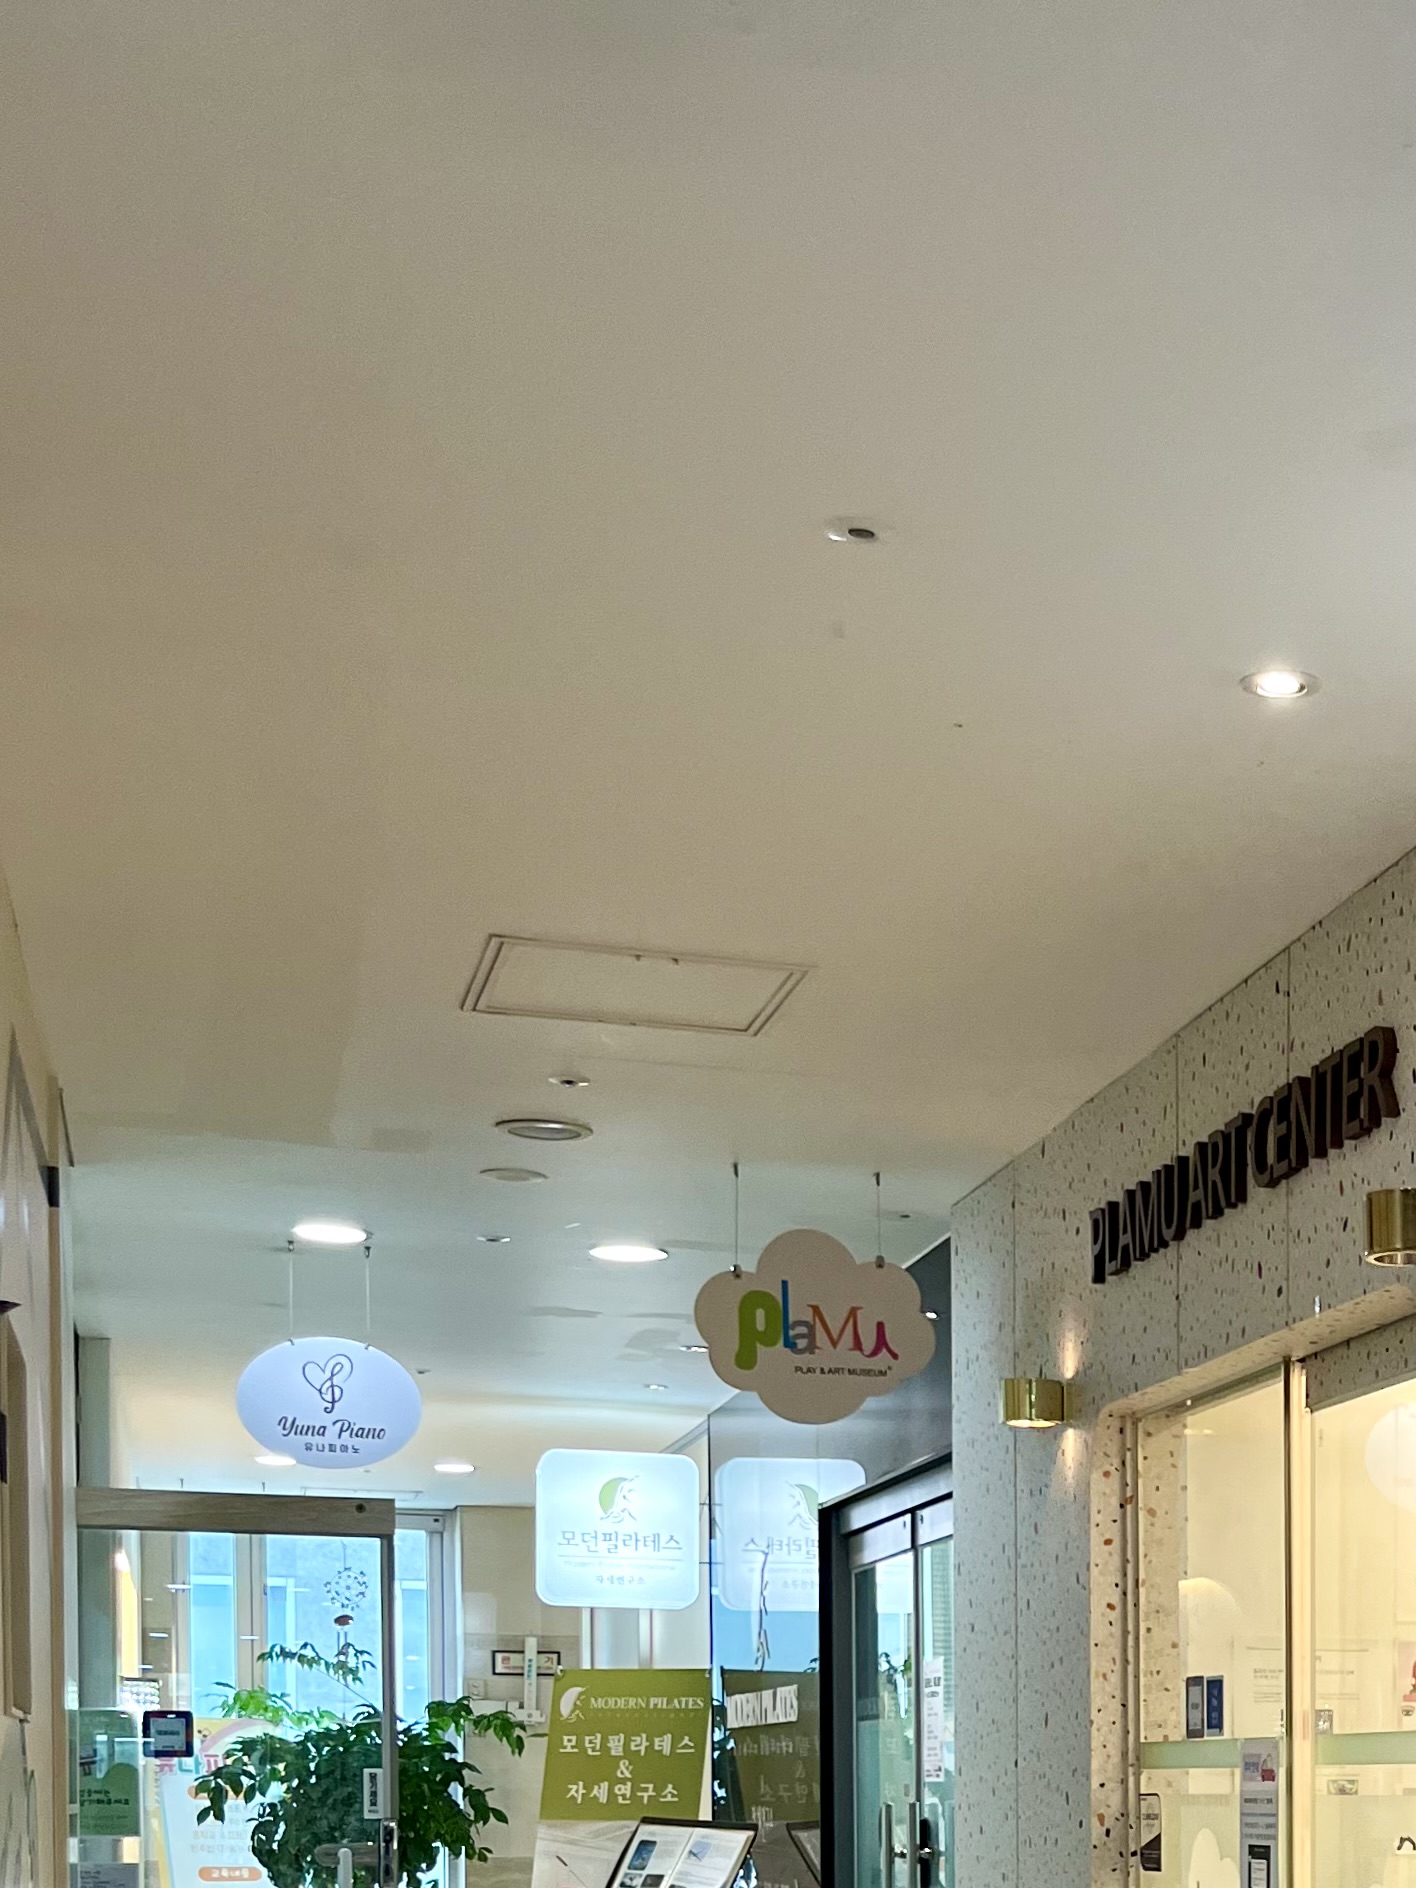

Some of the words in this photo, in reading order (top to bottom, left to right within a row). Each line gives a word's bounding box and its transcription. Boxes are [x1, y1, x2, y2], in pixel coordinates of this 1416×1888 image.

[1089, 1155, 1189, 1284] PLAMU
[1186, 1112, 1254, 1231] ART
[1250, 1025, 1400, 1188] CENTER
[795, 1366, 817, 1375] PLAY
[827, 1366, 846, 1376] ART
[277, 1416, 327, 1437] Yuna
[332, 1419, 386, 1440] Piano
[304, 1442, 360, 1454] 유나피아노
[557, 1531, 683, 1554] 모던필라테스
[590, 1697, 647, 1709] MODERN
[649, 1697, 705, 1709] PILATES
[560, 1733, 695, 1756] 모던필라테스
[616, 1759, 633, 1778] &
[566, 1781, 679, 1804] 자세연구소
